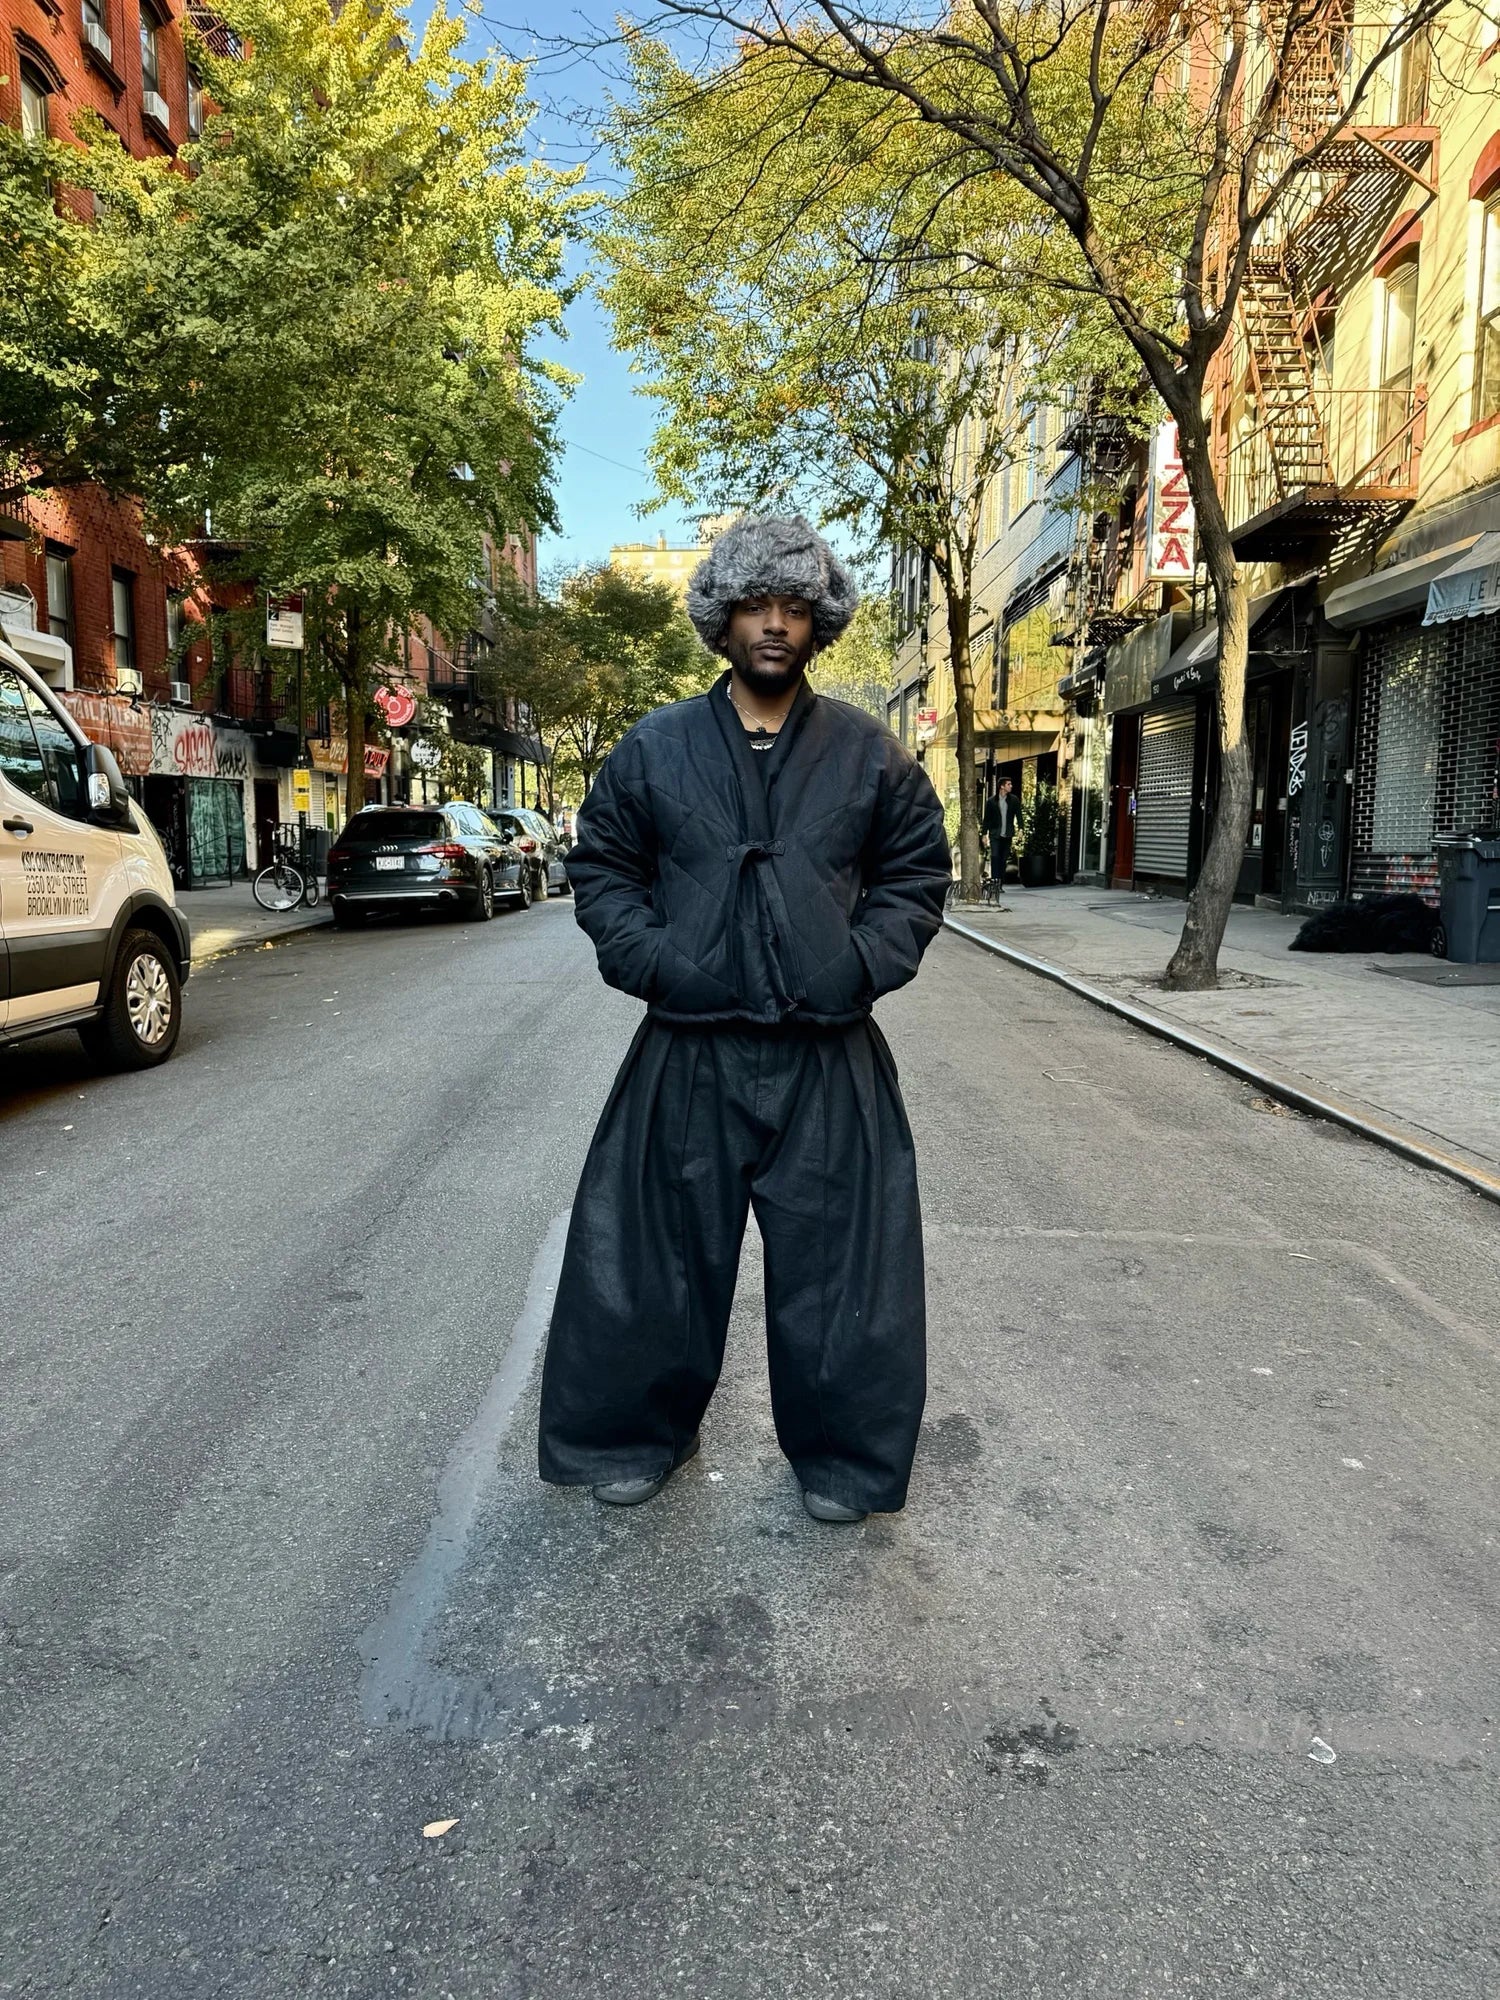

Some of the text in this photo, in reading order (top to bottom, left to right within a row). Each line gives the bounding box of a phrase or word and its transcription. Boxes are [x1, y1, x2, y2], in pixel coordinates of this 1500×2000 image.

[1468, 580, 1488, 602] LE
[21, 851, 35, 872] KSC
[34, 851, 75, 873] CONTRACTOR
[25, 875, 45, 894] 2350
[62, 876, 88, 895] STREET
[27, 896, 89, 916] BROOKLYN NY 11214
